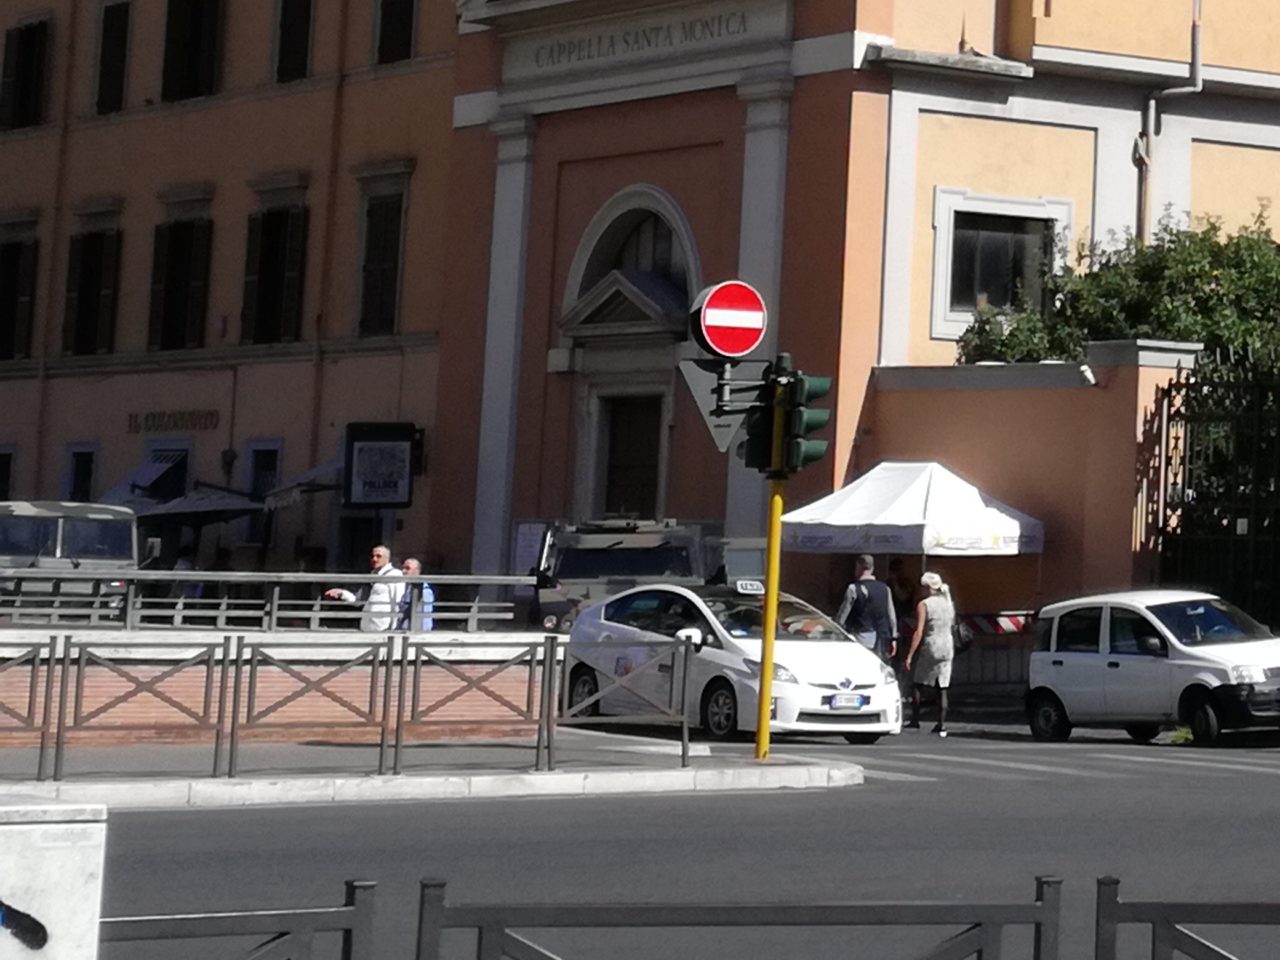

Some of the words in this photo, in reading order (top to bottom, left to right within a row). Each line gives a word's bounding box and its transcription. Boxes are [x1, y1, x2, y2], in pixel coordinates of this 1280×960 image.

[535, 35, 617, 68] CAPPELLA
[622, 25, 674, 54] SANTA
[680, 12, 749, 44] MONICA
